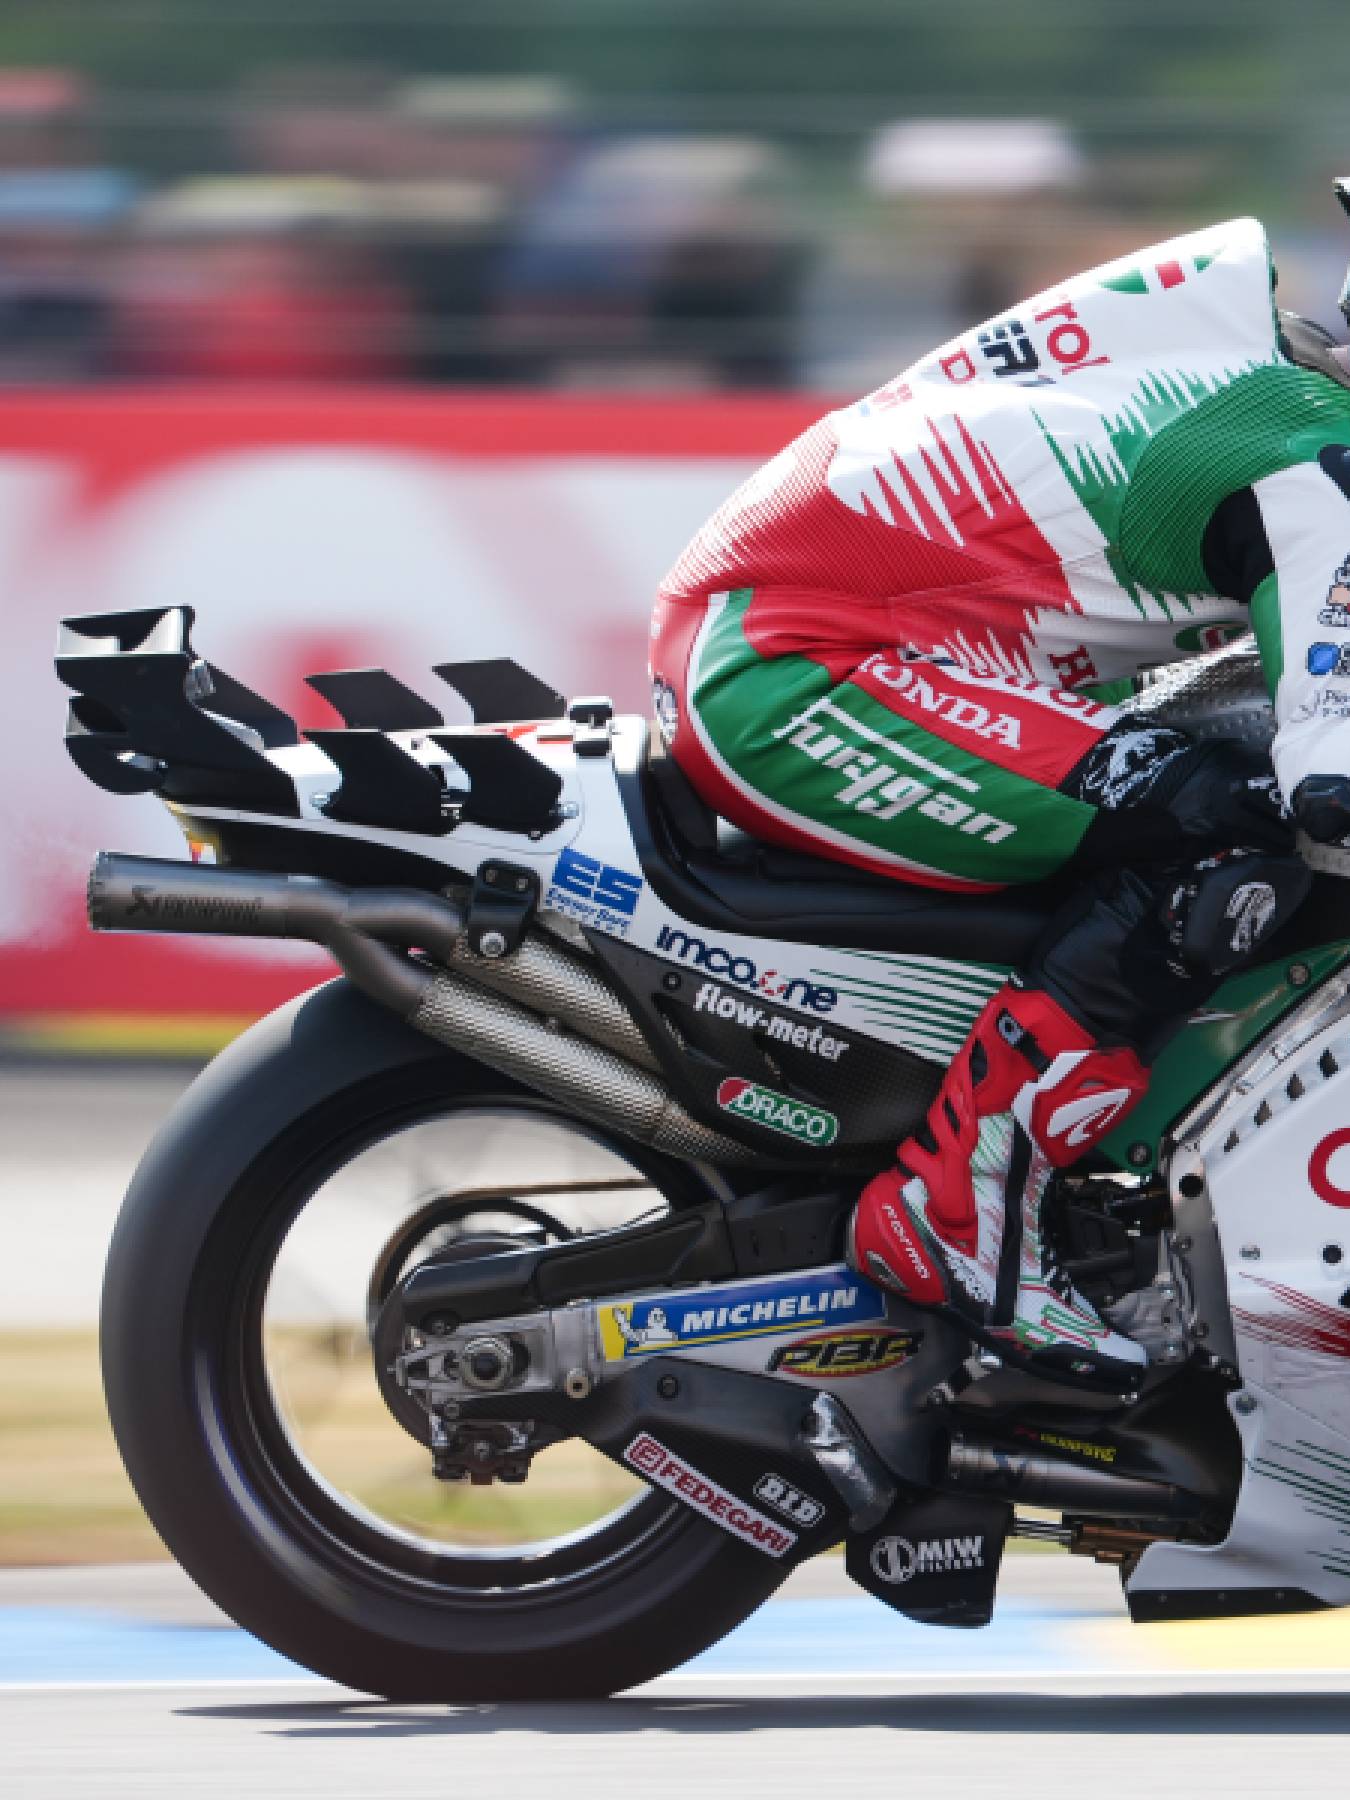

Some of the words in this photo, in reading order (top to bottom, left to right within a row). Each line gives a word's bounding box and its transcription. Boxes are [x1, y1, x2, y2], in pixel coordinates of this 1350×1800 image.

[551, 847, 643, 916] ES
[693, 983, 850, 1063] flow-meter
[737, 1084, 828, 1140] DRACO
[681, 1286, 857, 1332] MICHELIN
[766, 1330, 924, 1372] PBR
[660, 1461, 792, 1552] FEDEGARI
[918, 1536, 984, 1561] MIW
